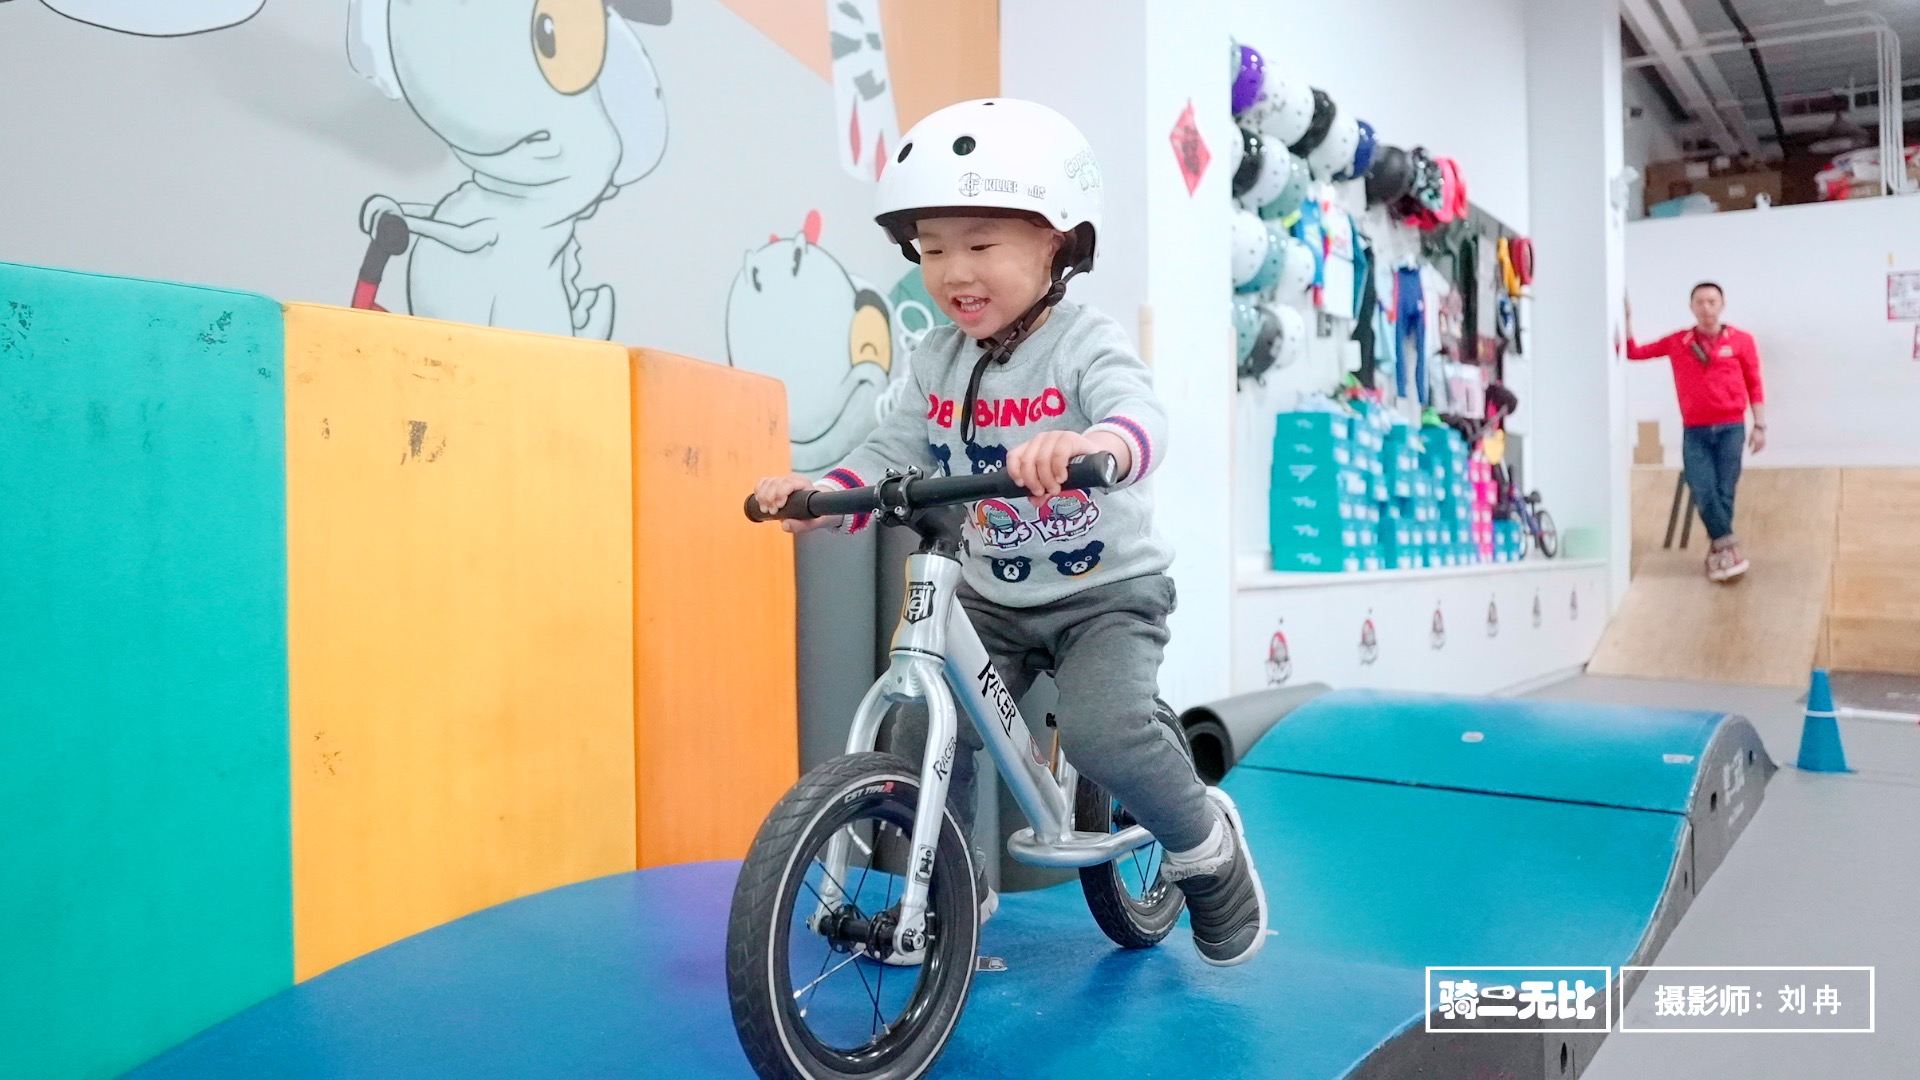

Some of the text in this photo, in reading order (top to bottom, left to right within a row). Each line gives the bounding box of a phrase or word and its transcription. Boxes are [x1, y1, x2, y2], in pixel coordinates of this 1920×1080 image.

[1026, 184, 1047, 200] ADS
[974, 387, 1066, 427] BINGO
[977, 659, 1017, 733] RACER
[933, 736, 957, 782] RACER
